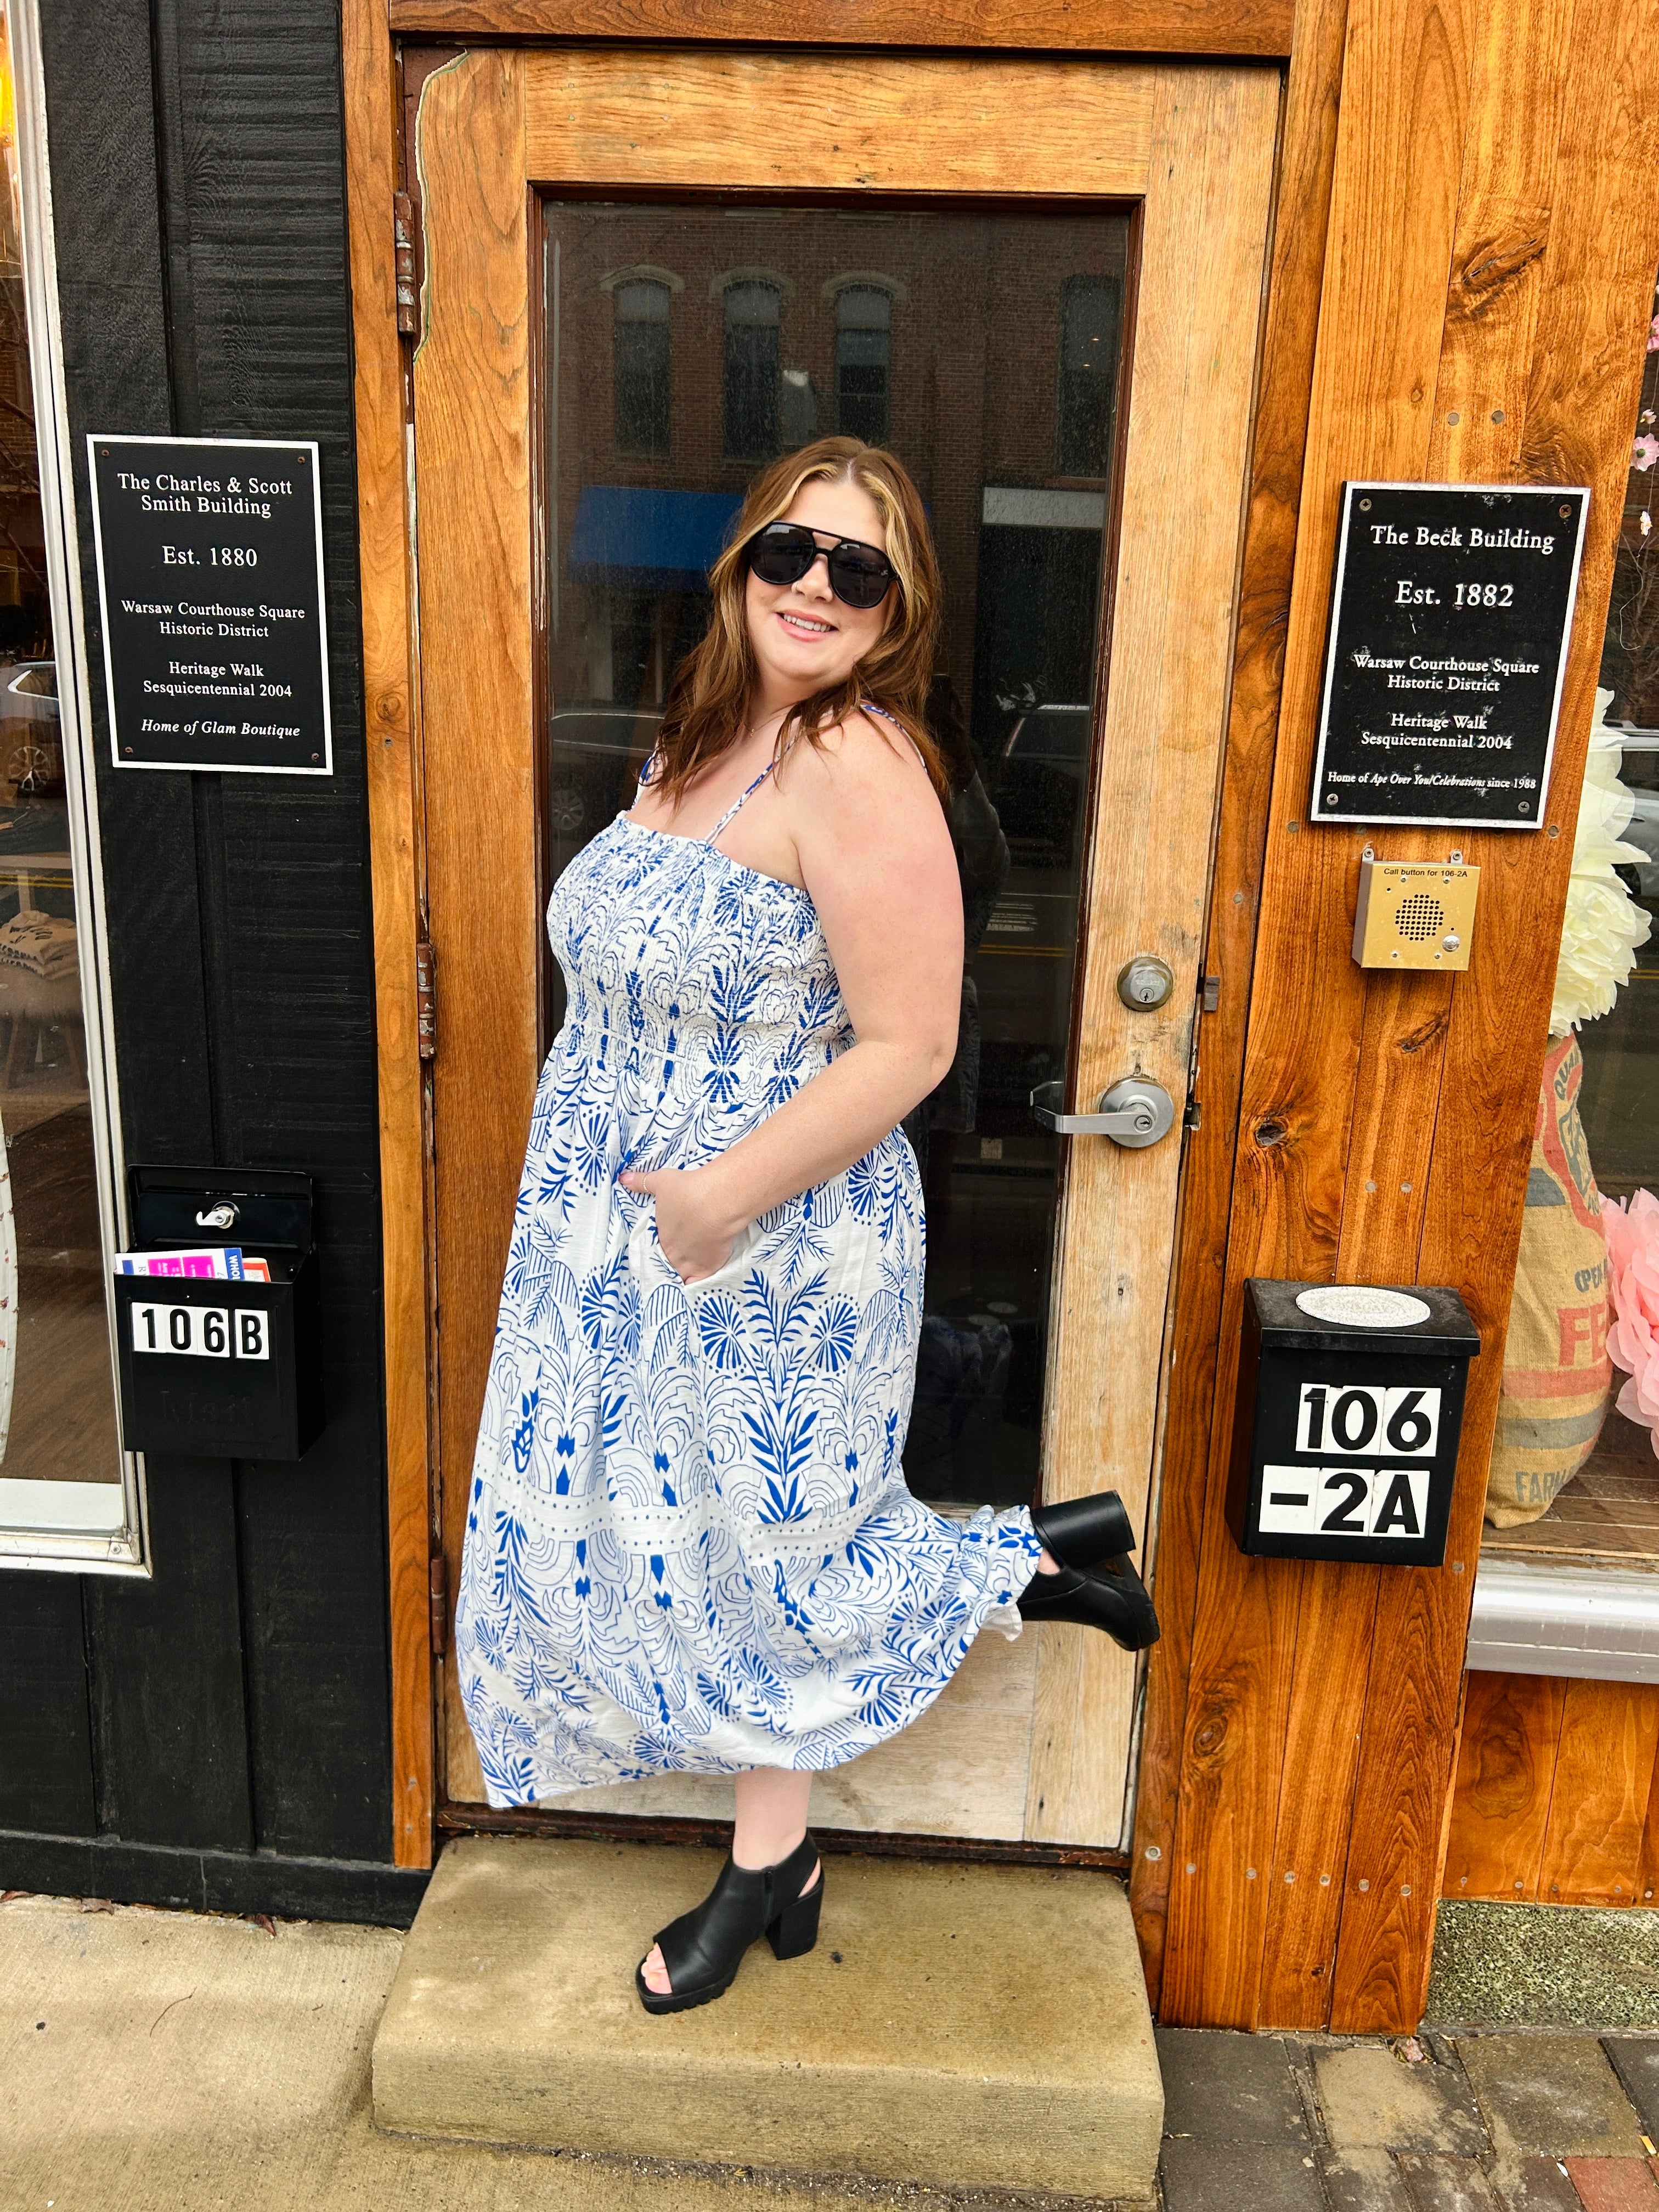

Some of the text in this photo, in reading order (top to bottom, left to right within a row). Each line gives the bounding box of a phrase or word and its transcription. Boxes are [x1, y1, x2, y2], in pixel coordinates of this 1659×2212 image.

[117, 473, 292, 495] The Charles & Scott
[141, 494, 272, 519] Smith Building
[1370, 525, 1555, 555] The Beck Building
[162, 545, 257, 567] Est. 1880
[1395, 580, 1514, 607] Est. 1882
[121, 600, 305, 621] Warsaw Courthouse Square
[159, 621, 269, 637] Historic District
[168, 661, 264, 679] Heritage Walk
[1353, 654, 1539, 676] Warsaw Courthouse Square
[143, 680, 292, 697] Sesquicentennial 2004
[1387, 675, 1500, 692] Historic District
[141, 719, 300, 739] Home of Glam Boutique
[1390, 713, 1488, 731] Heritage Walk
[1361, 731, 1513, 749] Sesquicentennial 2004
[1328, 771, 1356, 783] Home
[1358, 772, 1370, 783] of
[1369, 773, 1388, 787] Ape
[1390, 774, 1412, 785] Over
[1486, 777, 1511, 788] since
[1514, 775, 1536, 789] 1988
[1557, 1301, 1607, 1366] FE
[1304, 1387, 1432, 1452] 106
[1269, 1472, 1421, 1535] -2A
